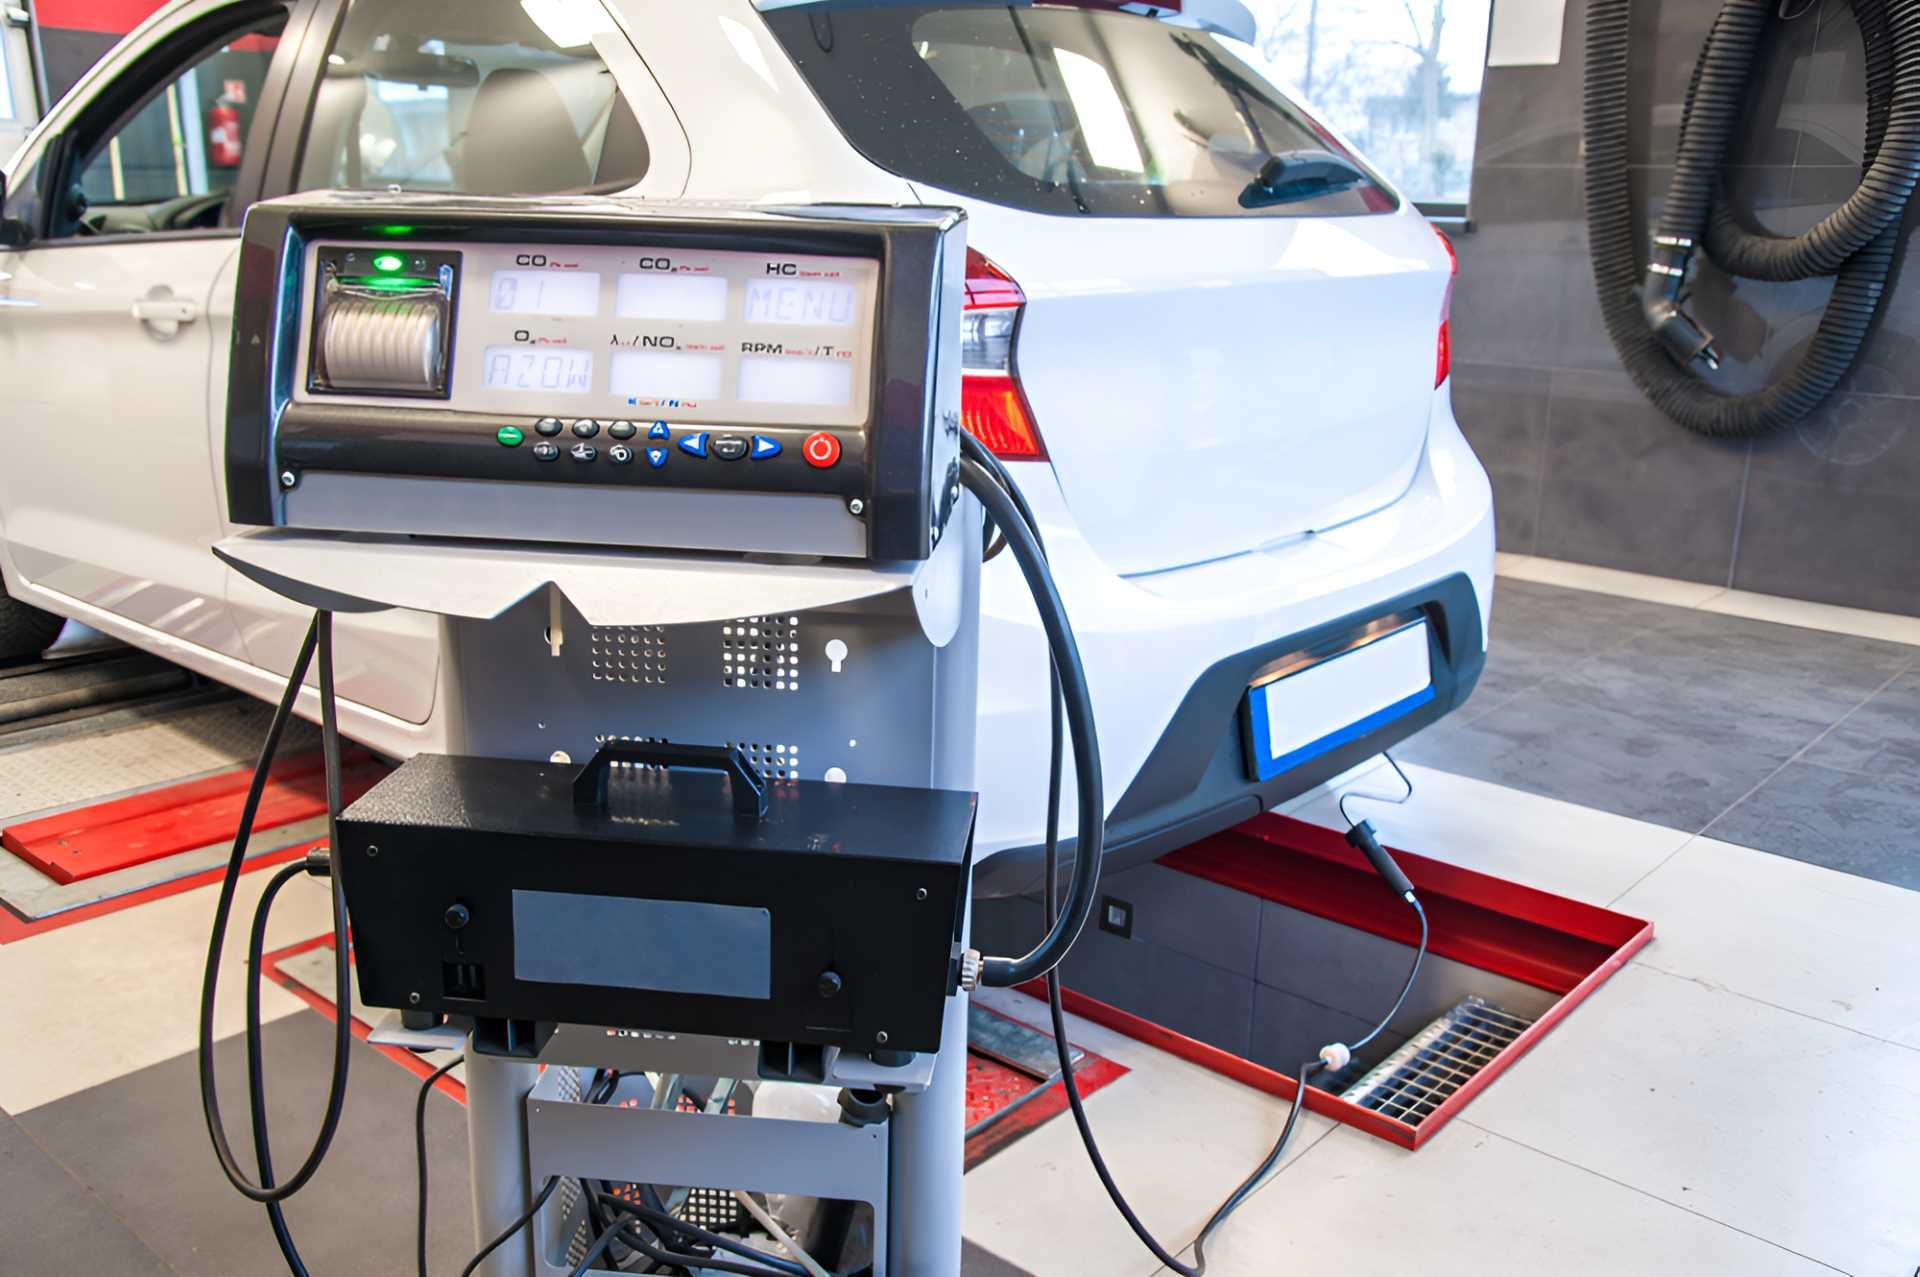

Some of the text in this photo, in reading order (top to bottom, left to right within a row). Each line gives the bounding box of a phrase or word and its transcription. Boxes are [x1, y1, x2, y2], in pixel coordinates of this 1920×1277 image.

[516, 254, 547, 267] CO
[766, 262, 797, 276] HC
[748, 287, 852, 322] MENU
[741, 342, 783, 354] RPM
